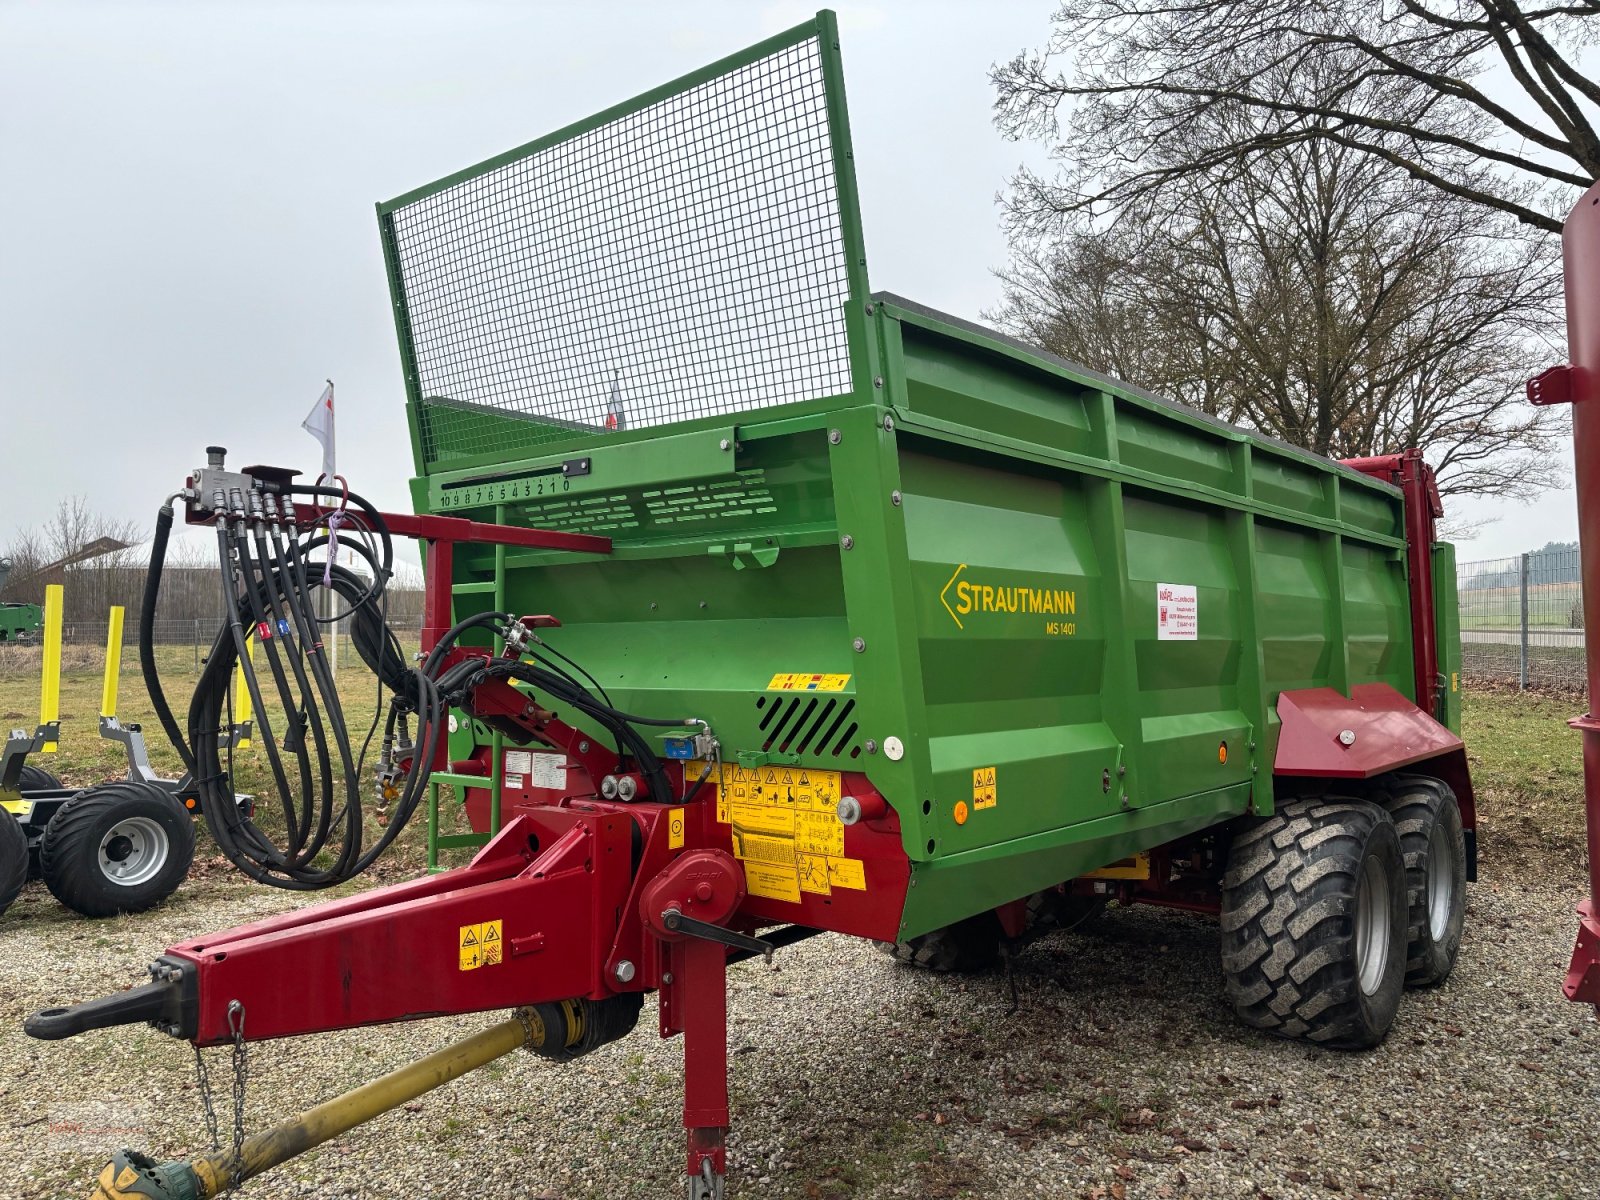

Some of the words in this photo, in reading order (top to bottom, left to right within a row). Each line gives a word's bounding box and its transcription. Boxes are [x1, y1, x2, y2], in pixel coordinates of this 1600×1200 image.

[440, 496, 450, 506] 10
[454, 495, 459, 505] 9
[465, 494, 470, 504] 8
[476, 492, 482, 502] 7
[488, 490, 494, 500] 6
[500, 489, 506, 499] 5
[512, 487, 518, 498] 4
[525, 486, 530, 496] 3
[538, 484, 543, 494] 2
[551, 482, 555, 492] 1
[564, 480, 569, 491] 0
[956, 581, 1075, 614] STRAUTMANN
[1046, 622, 1059, 635] MS
[1060, 623, 1075, 635] 1401
